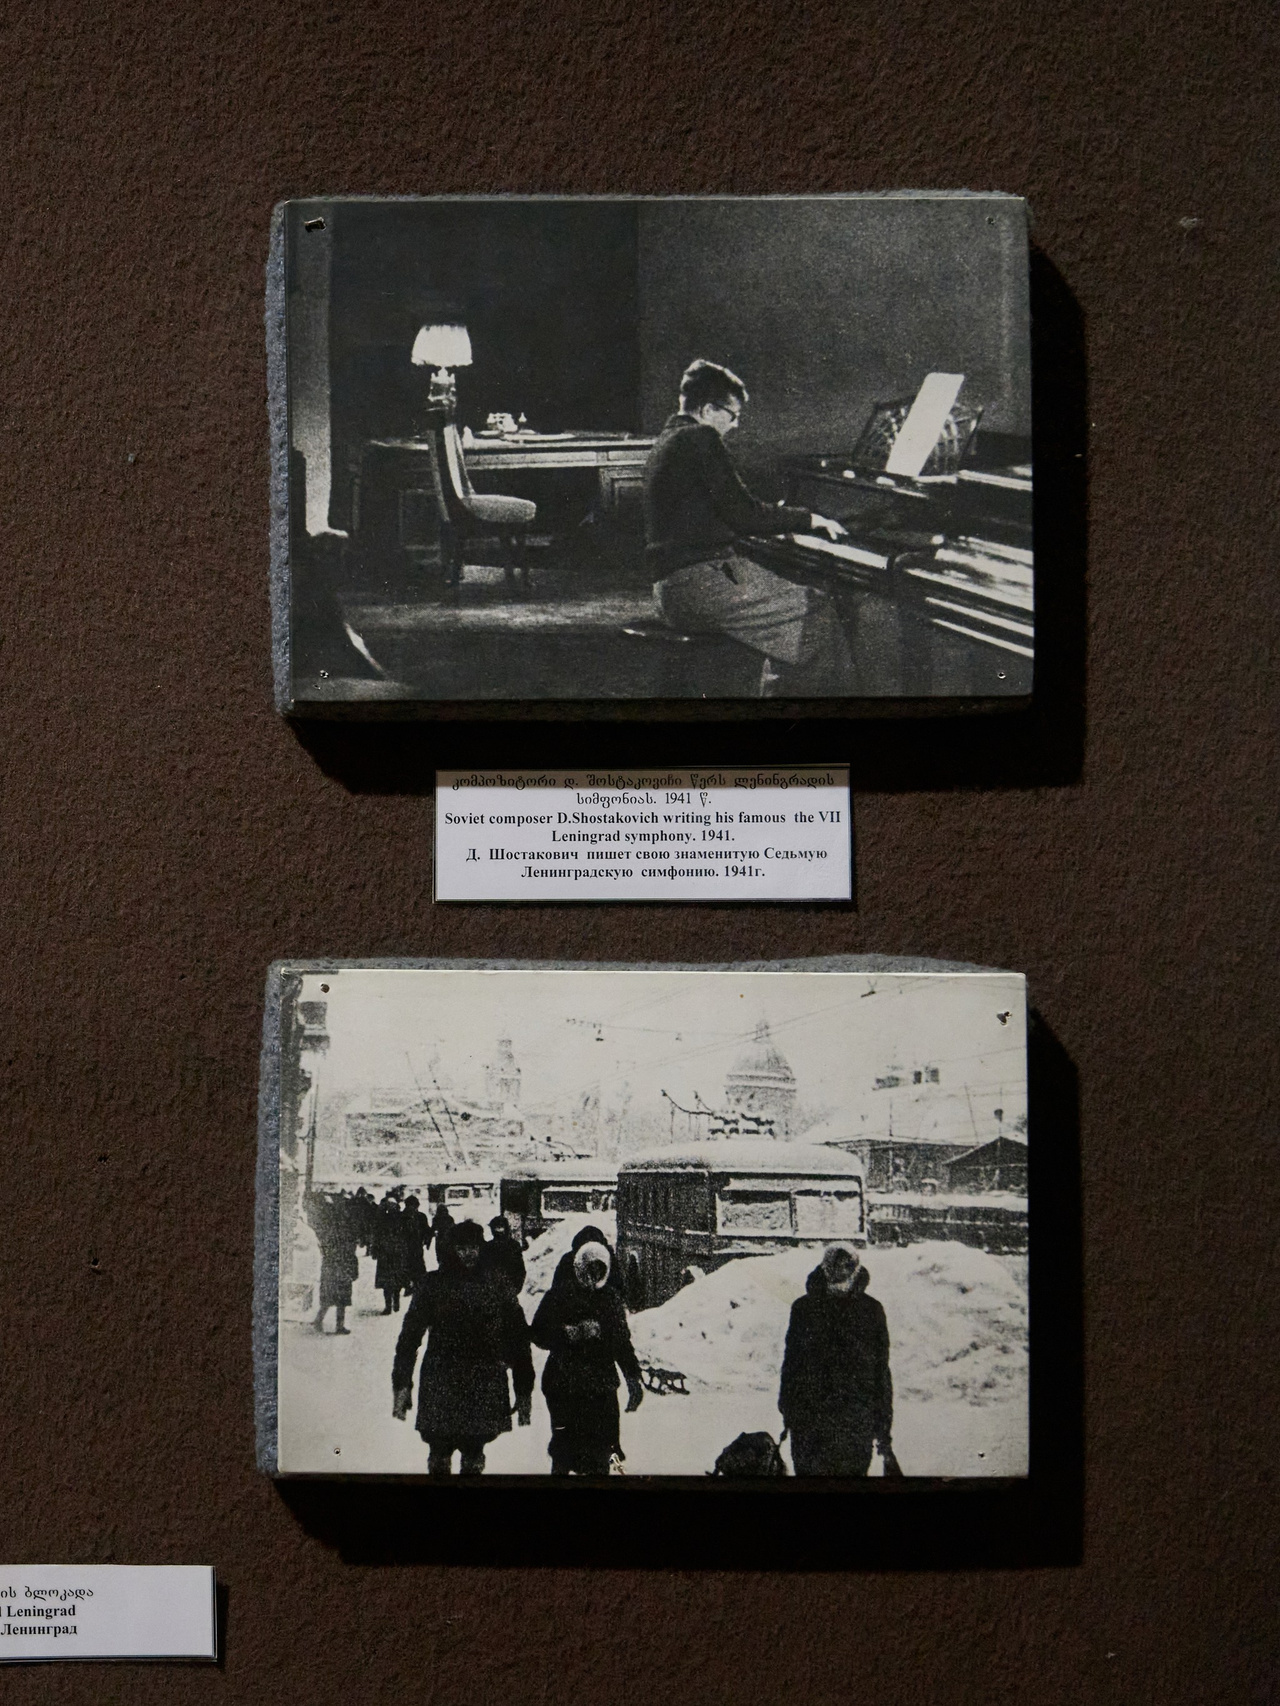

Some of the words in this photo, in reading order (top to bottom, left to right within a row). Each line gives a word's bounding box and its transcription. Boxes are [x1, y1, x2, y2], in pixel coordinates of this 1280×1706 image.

[452, 774, 556, 791] კომპოზიტორი
[564, 777, 579, 790] დ.
[586, 773, 682, 790] შოსტაკოვიჩი
[690, 773, 726, 790] წერს
[734, 773, 834, 789] ლენინგრადის
[576, 792, 657, 809] სიმფონიას.
[665, 792, 691, 804] 1941
[699, 791, 712, 808] წ.
[445, 813, 485, 825] Soviet
[489, 814, 553, 827] composer
[557, 812, 659, 824] D.Shostakovich
[663, 812, 711, 826] writing
[716, 812, 734, 823] his
[738, 812, 786, 823] famous
[794, 811, 815, 823] the
[818, 810, 841, 823] VII
[552, 830, 620, 844] Leningrad
[624, 830, 696, 844] symphony.
[701, 829, 735, 841] 1941.
[466, 848, 481, 862] Д.
[489, 849, 579, 860] Шостакович
[587, 850, 632, 860] пишет
[635, 850, 670, 860] свою
[674, 849, 760, 862] знаменитую
[764, 847, 828, 862] Седьмую
[521, 866, 634, 880] Ленинградскую
[641, 865, 719, 880] симфонию.
[724, 865, 766, 877] 1941г.
[24, 1586, 94, 1601] ბლოკადა
[6, 1605, 76, 1619] Leningrad
[0, 1623, 78, 1637] Ленинград
